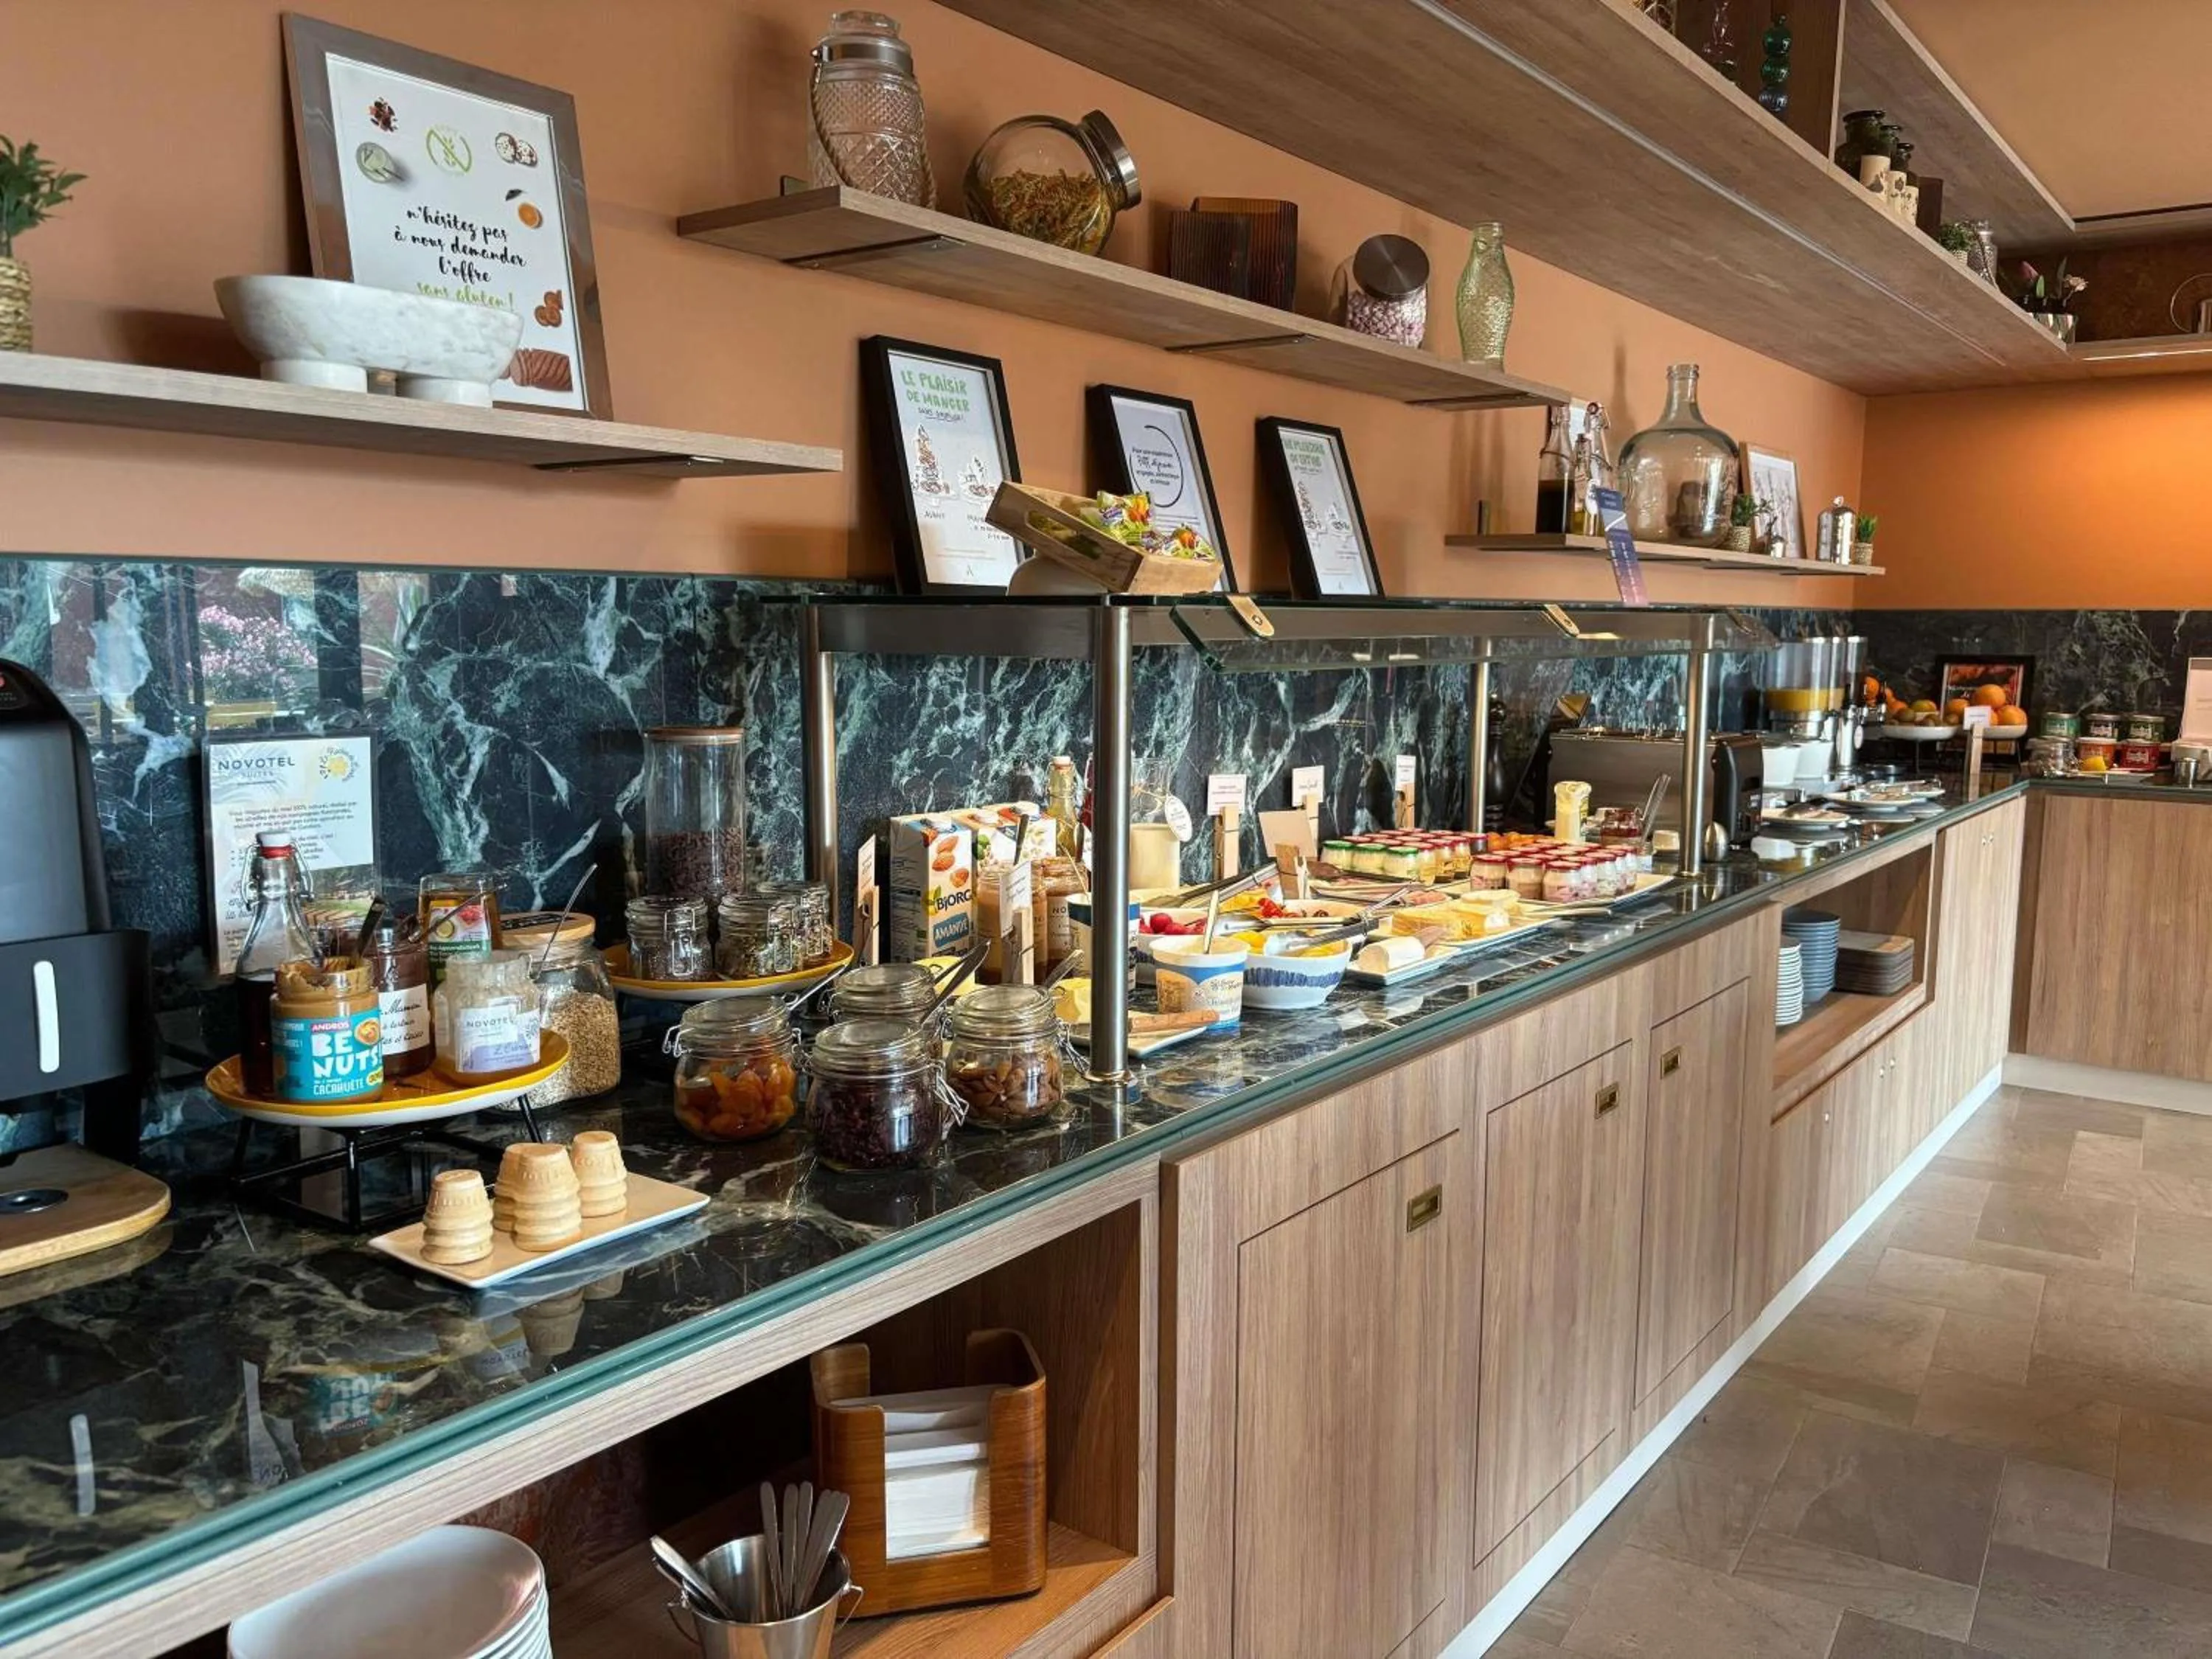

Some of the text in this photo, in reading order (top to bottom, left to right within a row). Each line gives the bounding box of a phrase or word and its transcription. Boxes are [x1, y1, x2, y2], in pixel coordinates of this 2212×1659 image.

[406, 206, 508, 244] n'hésitez pas
[394, 226, 527, 267] à nous demander
[439, 256, 491, 284] l'offre
[901, 370, 916, 386] LE
[906, 389, 920, 403] DE
[218, 757, 295, 771] NOVOTEL
[312, 1022, 349, 1032] ANDROS
[311, 1030, 352, 1057] BE
